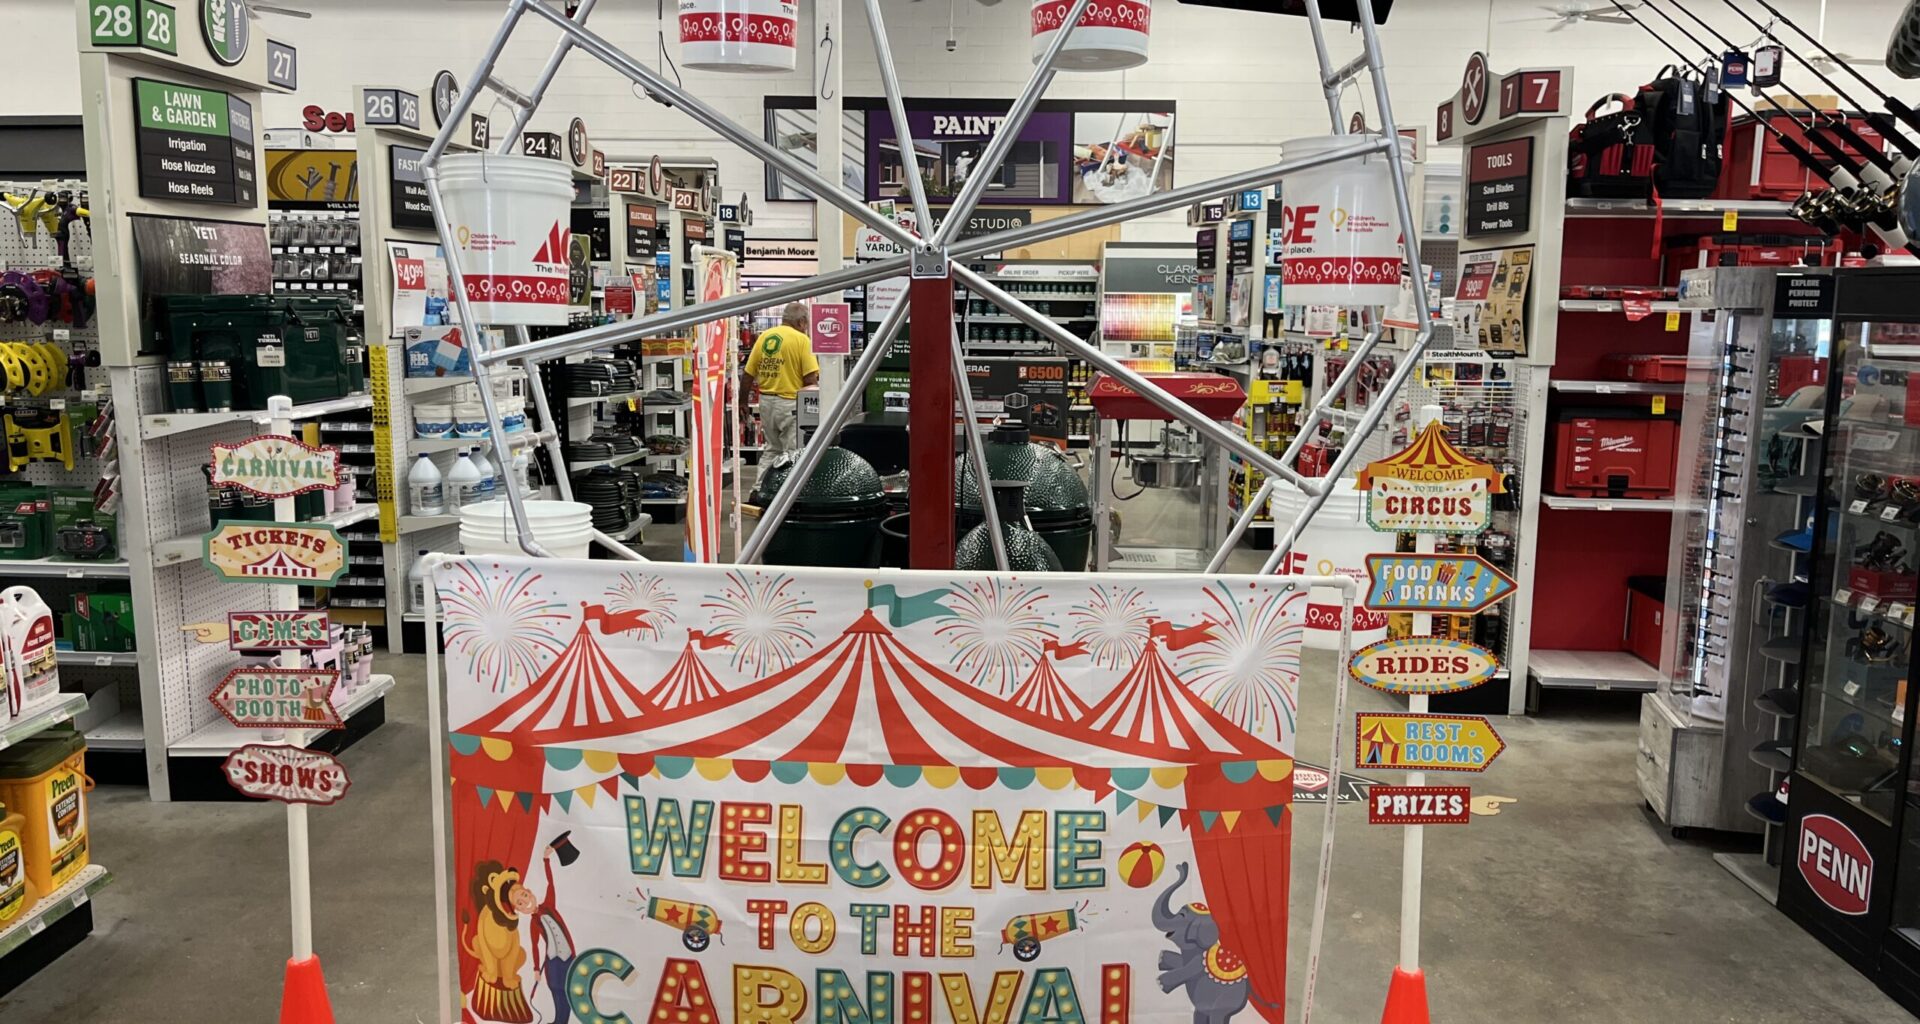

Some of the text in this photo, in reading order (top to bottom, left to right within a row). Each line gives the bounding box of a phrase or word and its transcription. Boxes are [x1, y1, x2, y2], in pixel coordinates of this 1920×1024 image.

[94, 4, 133, 37] 28
[146, 10, 171, 45] 28
[273, 51, 291, 80] 27
[164, 90, 202, 110] LAWN
[1506, 83, 1513, 109] 7
[1532, 79, 1549, 104] 7
[367, 95, 394, 118] 26
[402, 99, 416, 122] 26
[152, 106, 216, 129] & GARDEN
[933, 116, 1004, 135] PAINT
[1441, 110, 1447, 132] 8
[475, 121, 487, 141] 25
[168, 136, 206, 153] Irrigation
[525, 138, 547, 155] 24
[551, 139, 560, 157] 24
[162, 158, 216, 175] Hose Nozzles
[594, 155, 602, 172] 23
[1487, 153, 1513, 169] TOOLS
[168, 181, 214, 196] Hose Reels
[613, 173, 631, 188] 22
[1483, 182, 1514, 196] Saw Blades
[405, 186, 416, 195] Wall
[405, 201, 419, 211] Wood
[676, 193, 692, 206] 20
[1245, 194, 1259, 207] 13
[1486, 200, 1510, 212] Drill Bits
[721, 207, 733, 219] 18
[1210, 207, 1222, 219] 15
[1481, 218, 1513, 230] Power Tools
[193, 226, 217, 241] YETI
[746, 247, 786, 258] Benjamin
[787, 247, 815, 256] Moore
[865, 243, 892, 252] YARD
[179, 253, 242, 266] SEASONAL COLOR
[535, 264, 552, 273] The
[1157, 264, 1198, 274] CLARK
[1790, 279, 1820, 287] EXPLORE
[1788, 289, 1820, 297] PERFORM
[1788, 299, 1818, 307] PROTECT
[304, 330, 319, 341] YETI
[1028, 366, 1064, 379] 6500
[222, 457, 327, 480] CARNIVAL
[1394, 467, 1465, 481] WELCOME
[1413, 485, 1443, 493] TO THE
[1385, 496, 1473, 517] CIRCUS
[227, 530, 327, 554] TICKETS
[1383, 564, 1432, 581] FOOD
[1400, 584, 1475, 601] DRINKS
[239, 620, 322, 641] GAMES
[1376, 656, 1469, 674] RIDES
[235, 679, 300, 696] PHOTO
[235, 700, 300, 717] BOOTH
[1405, 722, 1462, 741] REST
[1405, 743, 1485, 764] ROOMS
[245, 761, 332, 792] SHOWS
[52, 774, 75, 798] Preen
[55, 793, 77, 812] EXTENDED
[57, 802, 76, 819] CONTROL
[1377, 794, 1463, 816] PRIZES
[623, 795, 1107, 891] WELCOME
[1802, 830, 1868, 902] PENN
[746, 898, 975, 958] TO THE
